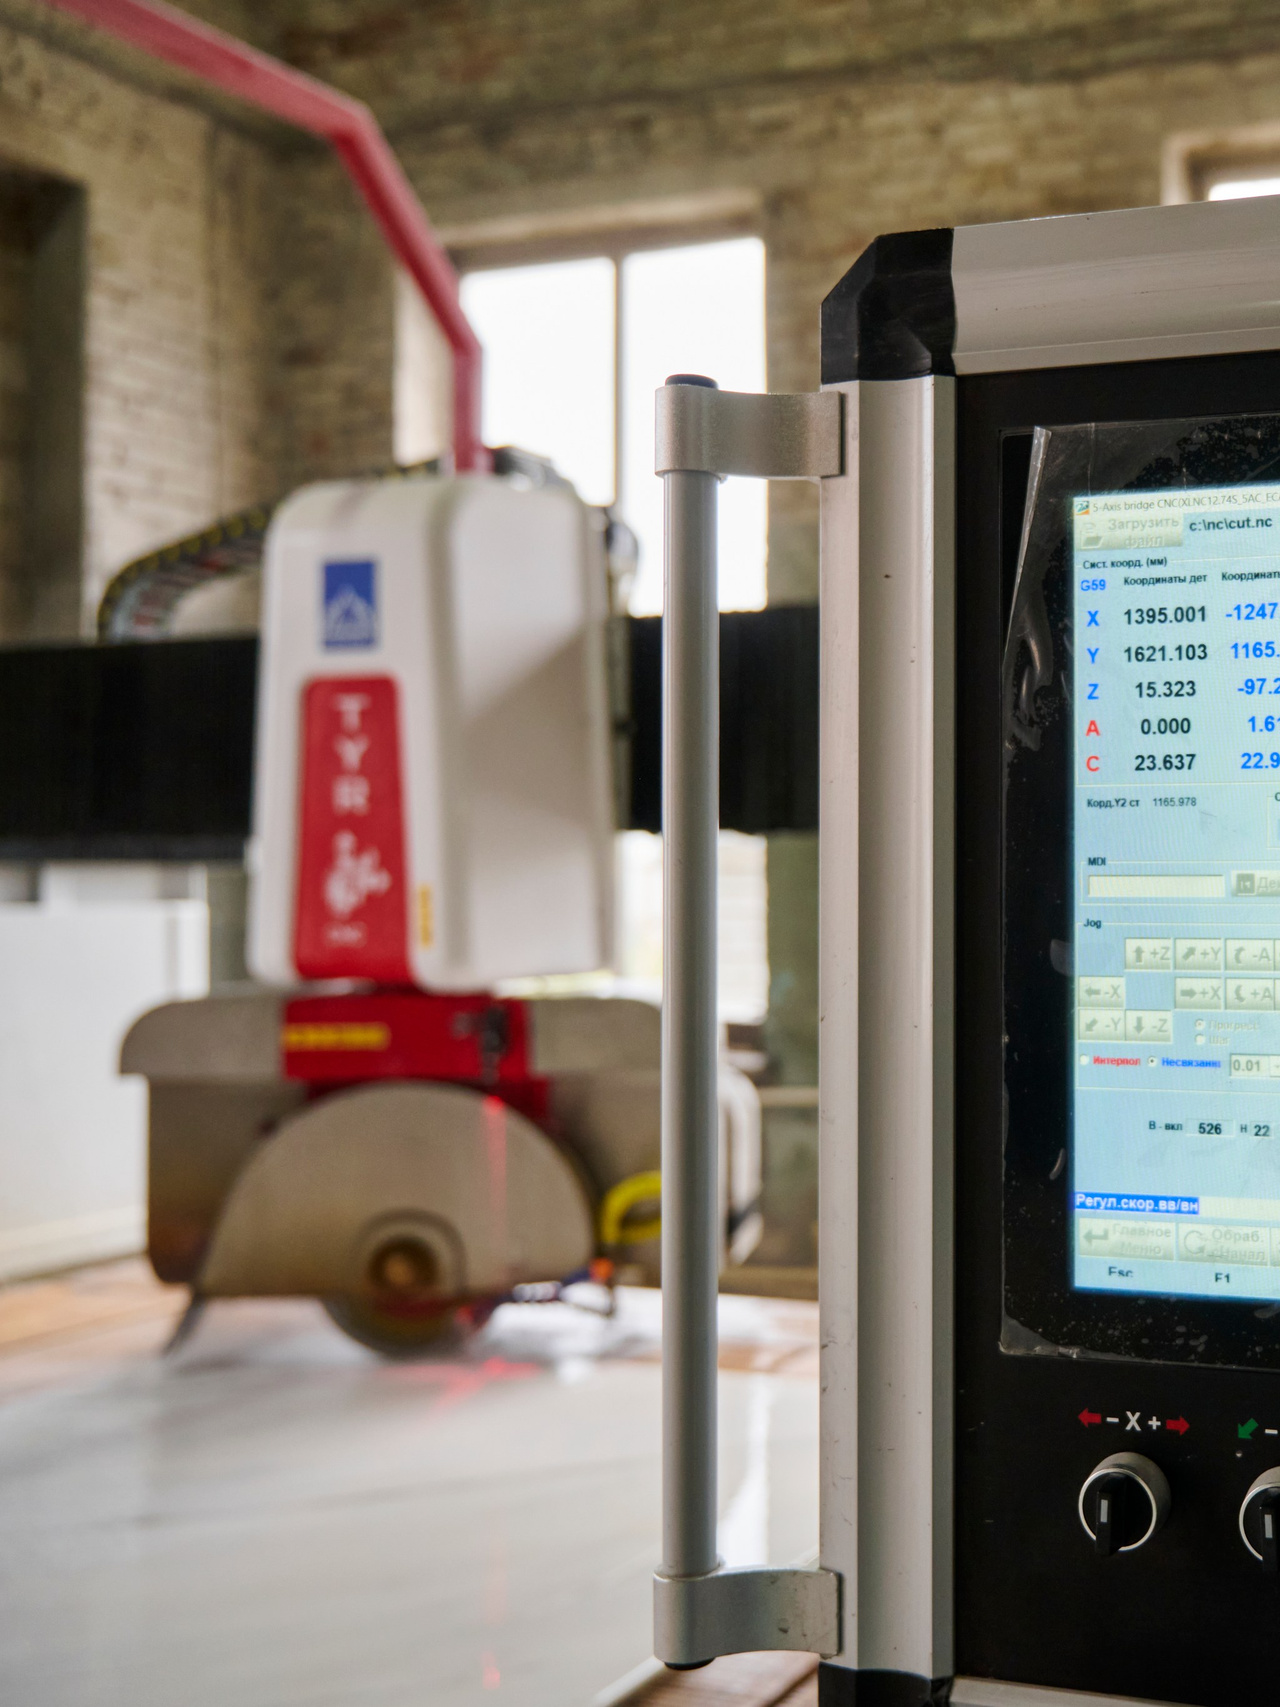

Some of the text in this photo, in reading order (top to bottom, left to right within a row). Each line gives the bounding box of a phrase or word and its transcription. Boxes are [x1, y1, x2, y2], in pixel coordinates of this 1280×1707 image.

[1093, 500, 1121, 513] 5-Axis
[1124, 500, 1155, 513] bridge
[1108, 518, 1179, 532] Загрузить
[1189, 516, 1273, 532] c:\nc\cut.nc
[1083, 557, 1167, 570] Сист. коорд. (мм)
[1080, 579, 1106, 591] G59
[1124, 573, 1207, 586] Координаты дет
[1087, 610, 1100, 627] X
[1124, 606, 1207, 625] 1395.001
[1087, 648, 1100, 664] Y
[1124, 644, 1208, 662] 1621.103
[1087, 684, 1100, 700] Z
[1135, 680, 1197, 698] 15.323
[1086, 720, 1101, 736] A
[1140, 718, 1191, 735] 0.000
[1086, 756, 1100, 771] C
[1134, 754, 1197, 771] 23.637
[1153, 797, 1197, 807] 1165.978
[1088, 857, 1107, 866] MDI
[1084, 919, 1102, 929] Jog
[1233, 1059, 1261, 1072] 0.01
[1165, 1122, 1183, 1131] вкл
[1199, 1122, 1222, 1135] 526
[1254, 1125, 1270, 1137] 22
[1077, 1194, 1198, 1211] Регул.скор.вв/вн
[1212, 1229, 1264, 1242] Обраб.
